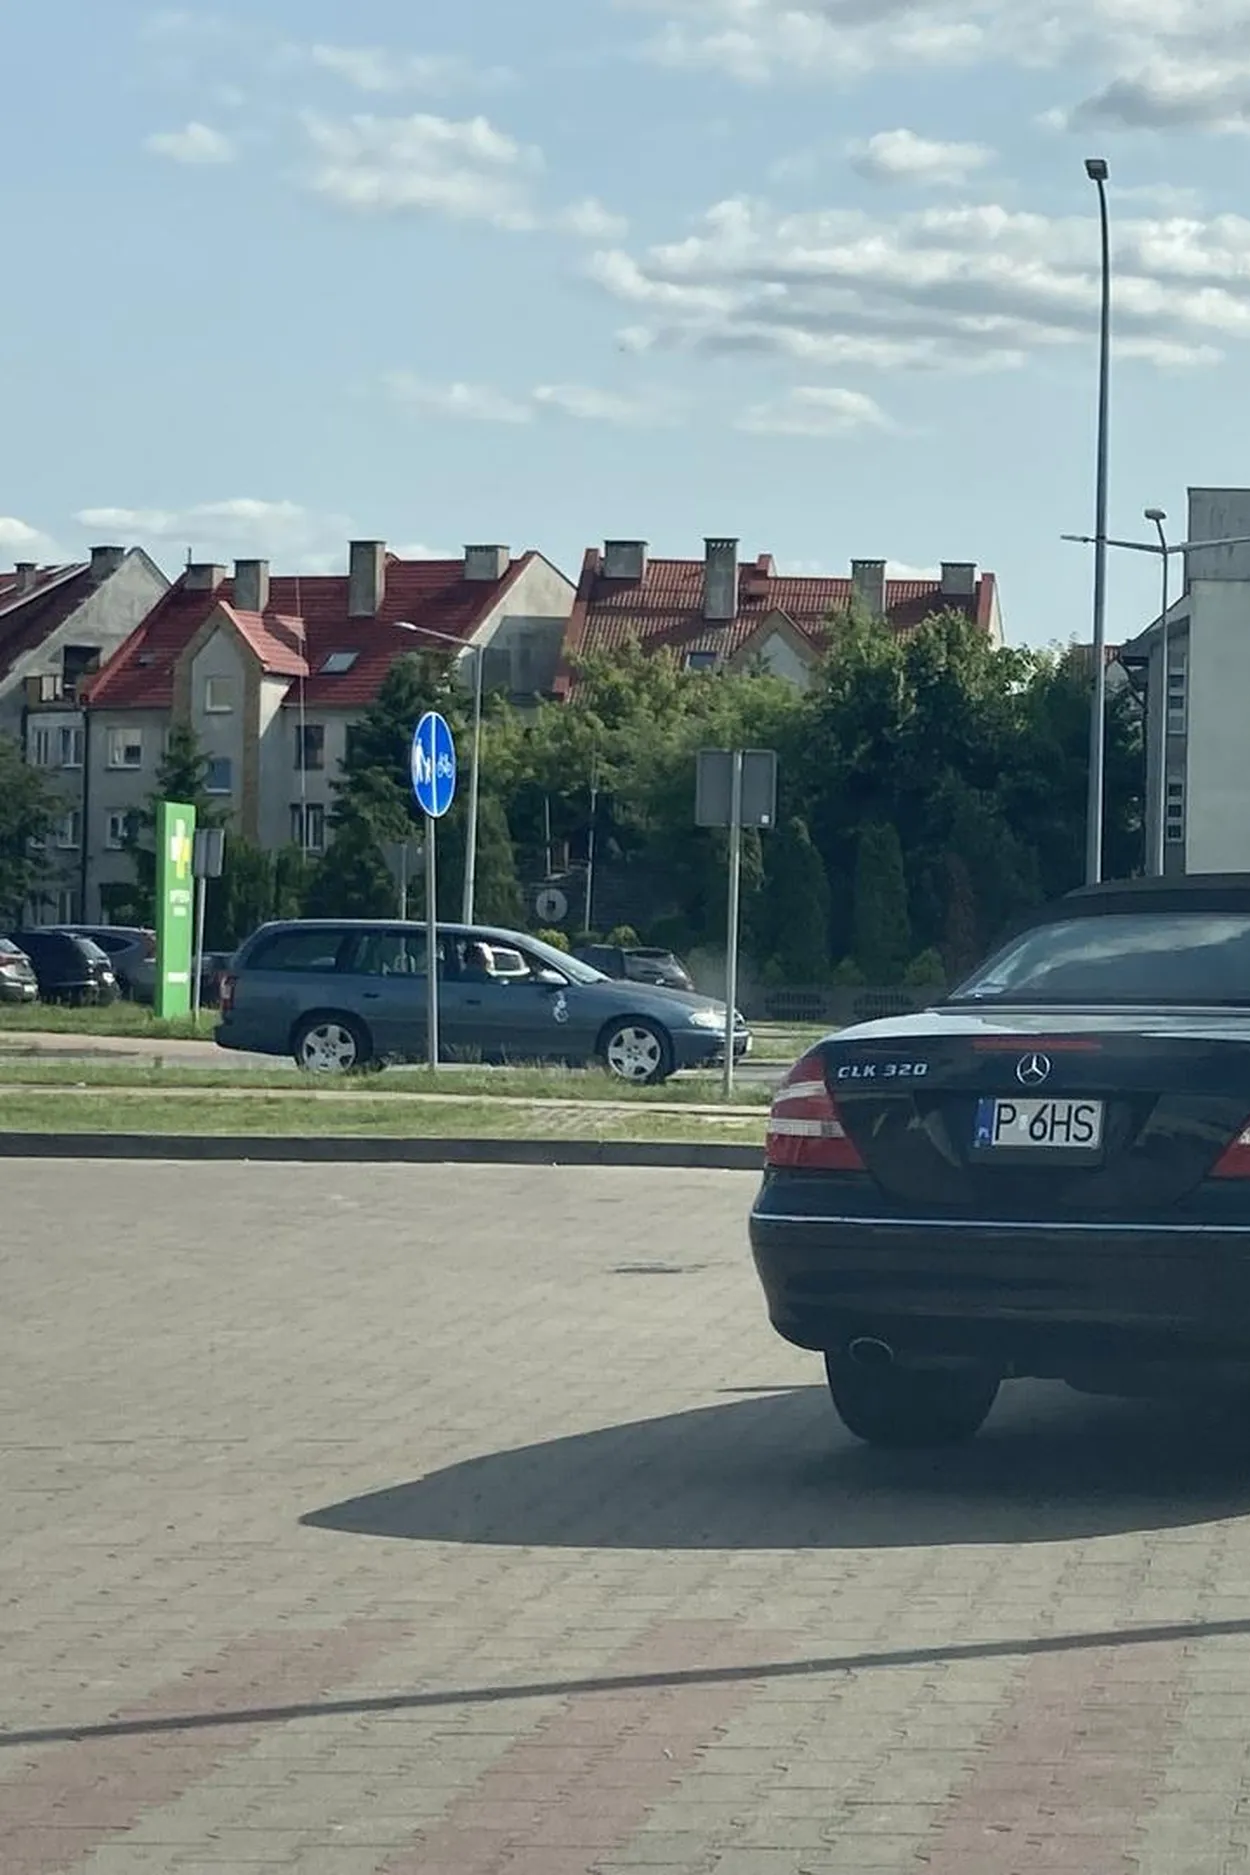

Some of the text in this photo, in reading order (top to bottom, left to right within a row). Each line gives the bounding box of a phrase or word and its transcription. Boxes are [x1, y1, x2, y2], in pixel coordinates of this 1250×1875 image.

[838, 1062, 929, 1079] CLK 320
[995, 1103, 1096, 1142] P 6HS
